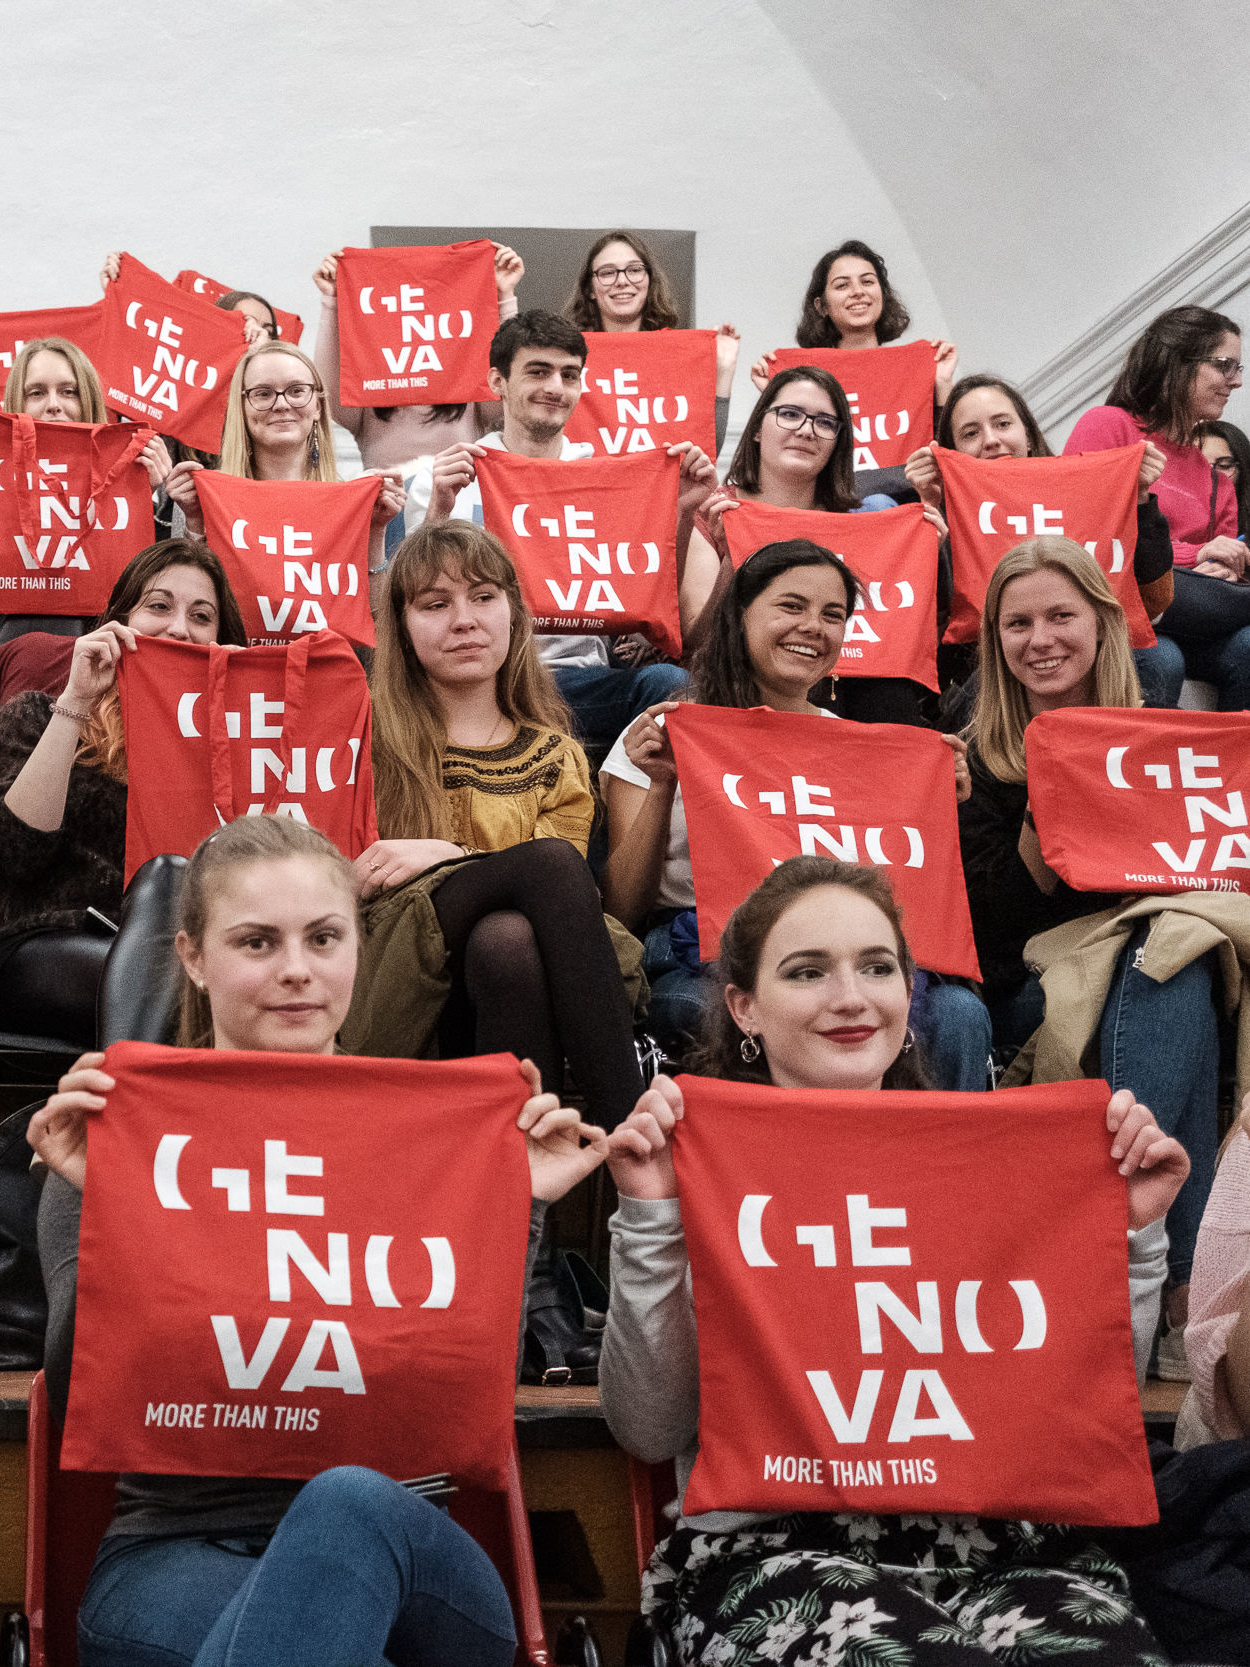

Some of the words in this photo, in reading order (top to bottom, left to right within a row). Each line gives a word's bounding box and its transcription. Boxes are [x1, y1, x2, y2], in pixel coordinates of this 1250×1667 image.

[360, 284, 424, 314] GE
[126, 301, 184, 348] GE
[401, 310, 472, 342] NO
[152, 345, 218, 390] NO
[381, 345, 443, 374] VA
[132, 366, 178, 412] VA
[363, 379, 386, 390] MORE
[387, 378, 408, 389] THAN
[409, 376, 428, 387] THIS
[581, 367, 638, 395] GE
[108, 387, 128, 404] MORE
[128, 394, 148, 414] THAN
[147, 404, 164, 420] THIS
[616, 395, 688, 424] NO
[598, 426, 656, 454] VA
[852, 446, 880, 472] A
[40, 496, 130, 530] NO
[512, 504, 596, 538] GE
[978, 501, 1064, 536] GE
[13, 536, 90, 570] VA
[232, 519, 313, 556] GE
[568, 542, 660, 574] NO
[20, 576, 46, 590] THAN
[48, 577, 71, 590] THIS
[284, 561, 358, 596] NO
[544, 578, 626, 612] VA
[256, 596, 328, 634] VA
[532, 617, 551, 627] ORE
[553, 618, 580, 628] THAN
[582, 618, 604, 628] THIS
[844, 614, 882, 642] A
[840, 648, 864, 658] THIS
[250, 738, 360, 794] NO
[1106, 746, 1223, 790] GE
[722, 773, 836, 817] GE
[1184, 790, 1248, 834] N
[798, 823, 925, 868] NO
[1151, 832, 1250, 873] VA
[1124, 873, 1166, 884] MORE
[1168, 876, 1208, 890] THAN
[1210, 878, 1240, 893] THIS
[153, 1134, 324, 1216] GE
[738, 1194, 912, 1268] GE
[266, 1227, 456, 1309] NO
[854, 1280, 1048, 1354] NO
[210, 1314, 367, 1395] VA
[144, 1402, 206, 1429] MORE
[212, 1404, 266, 1430] THAN
[273, 1406, 321, 1432] THIS
[805, 1369, 975, 1444] VA
[763, 1454, 824, 1484] MORE
[828, 1458, 884, 1488] THAN
[889, 1456, 938, 1486] THIS
